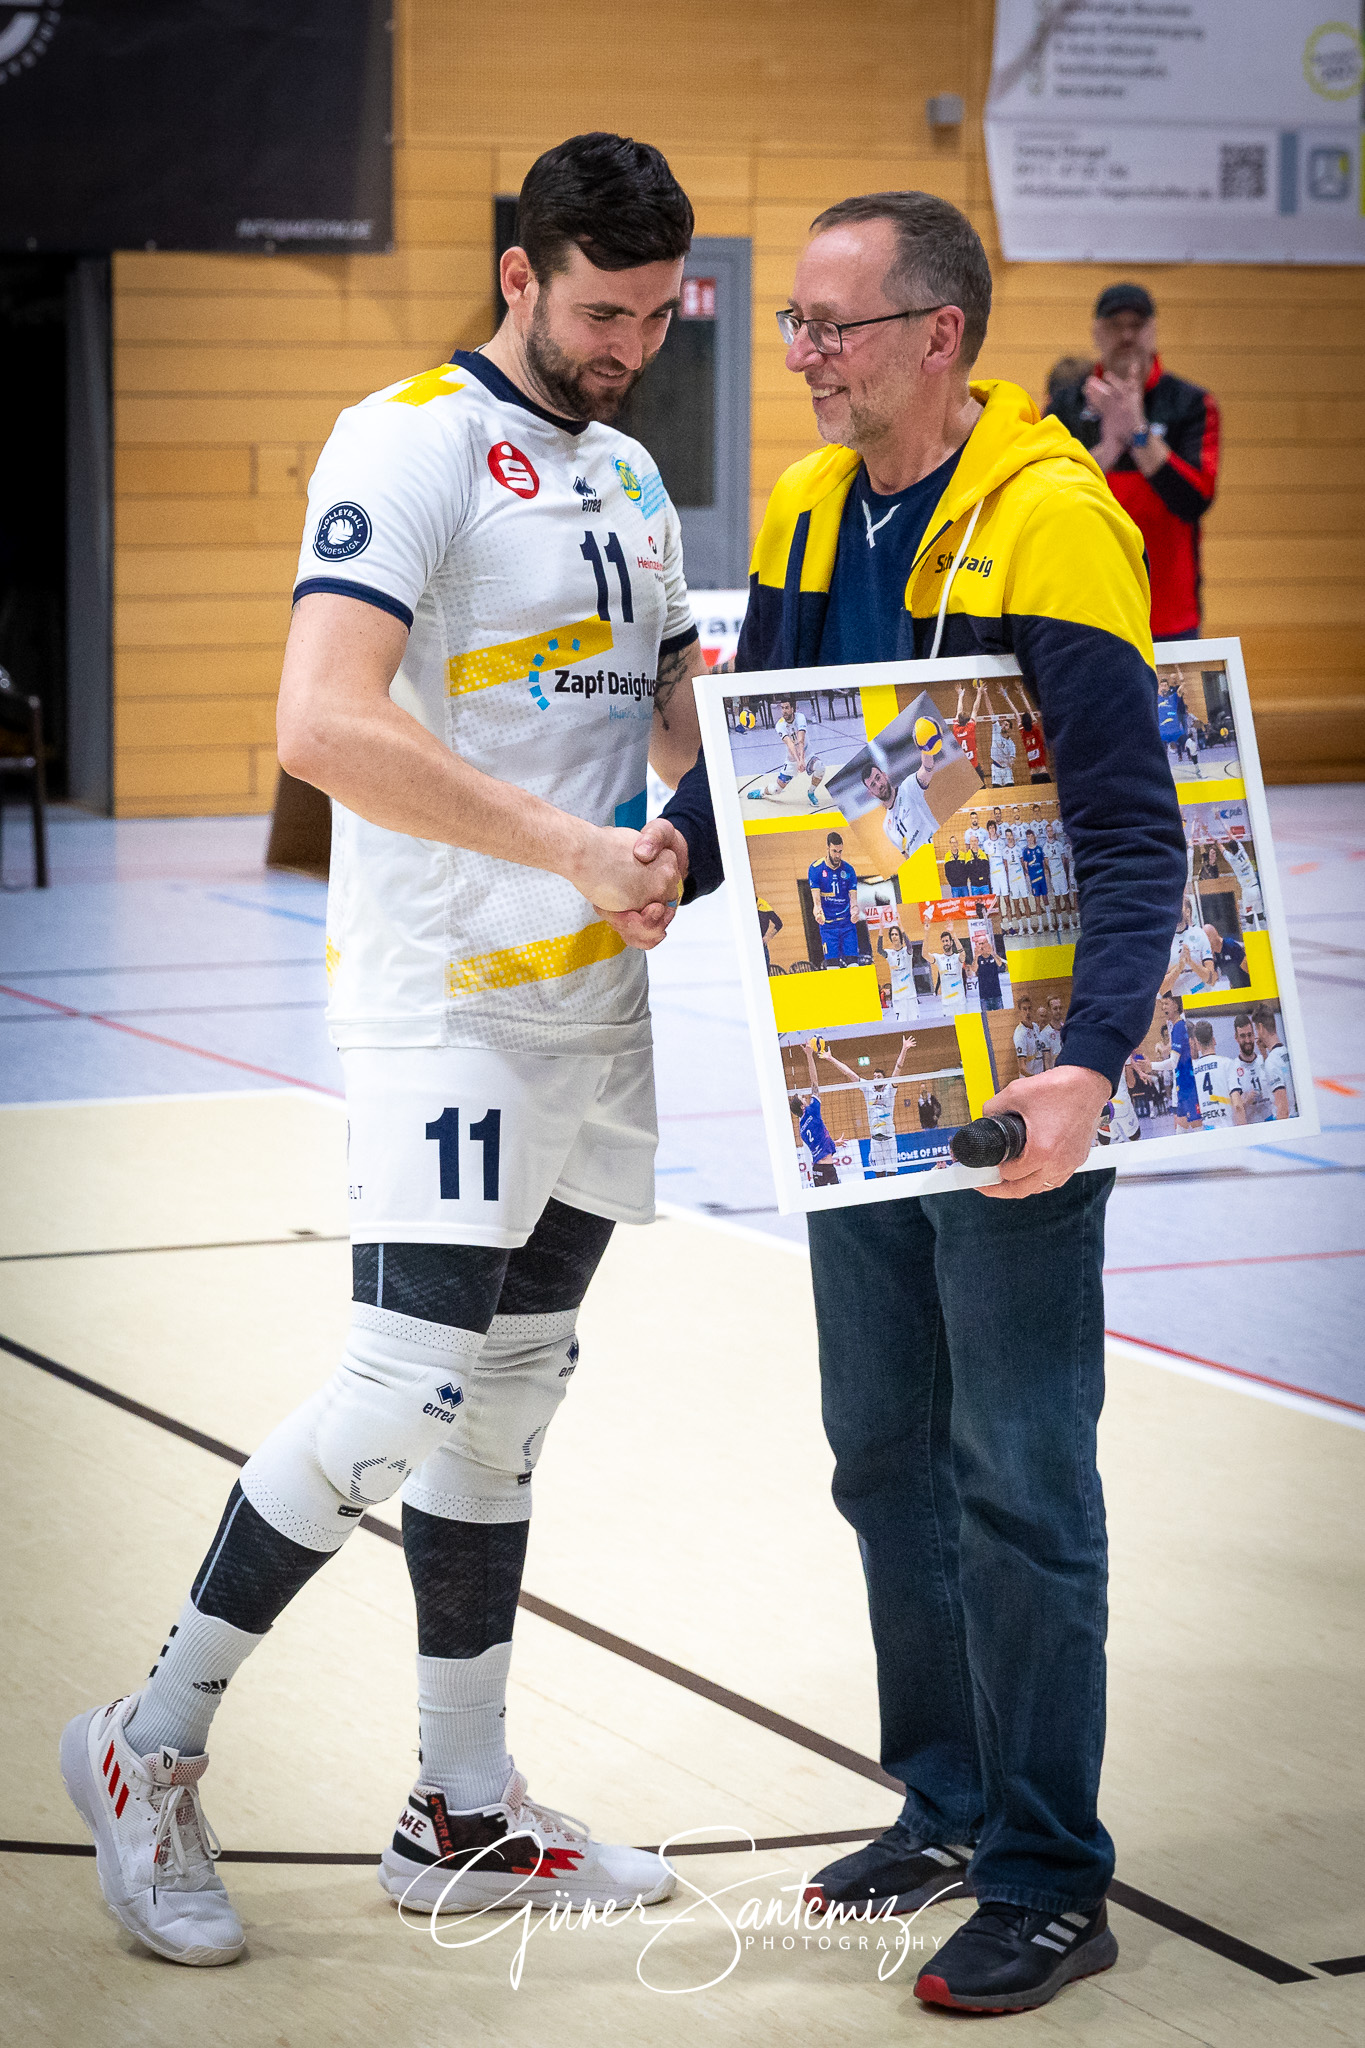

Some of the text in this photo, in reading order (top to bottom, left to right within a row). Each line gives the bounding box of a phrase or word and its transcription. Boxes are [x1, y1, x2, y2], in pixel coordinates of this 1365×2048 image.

[322, 509, 363, 530] VOLLEYBALL
[579, 530, 633, 623] 11
[554, 669, 604, 699] Zapf
[831, 881, 840, 894] 11
[1203, 1072, 1213, 1095] 4
[426, 1107, 501, 1201] 11
